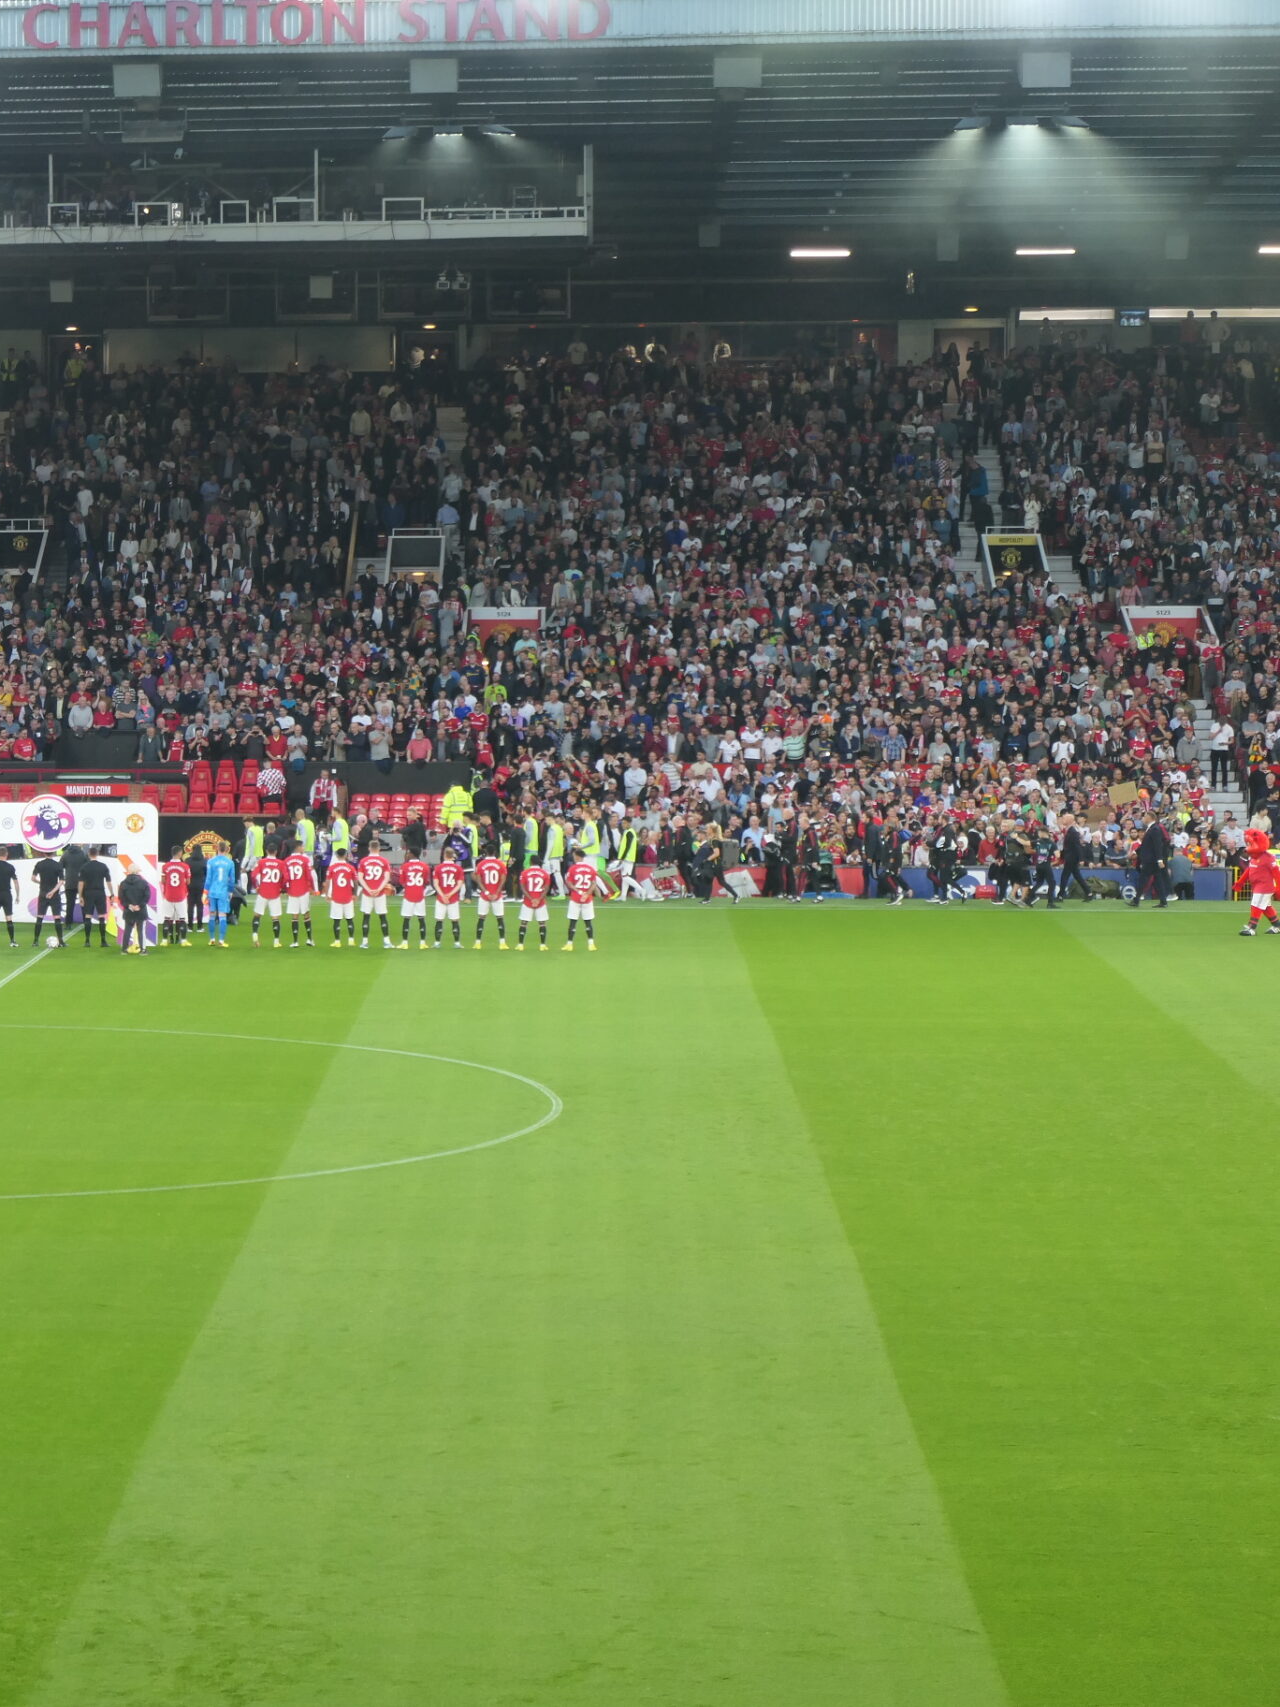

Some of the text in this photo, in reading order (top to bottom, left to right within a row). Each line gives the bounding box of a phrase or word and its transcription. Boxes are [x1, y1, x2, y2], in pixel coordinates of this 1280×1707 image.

[22, 0, 365, 49] CHARLTON
[398, 0, 610, 43] STAND
[65, 785, 112, 796] MANUTD.COM
[170, 872, 180, 887] 8
[217, 868, 224, 881] 1
[262, 868, 280, 883] 20
[288, 865, 303, 880] 19
[337, 872, 347, 887] 6
[365, 866, 383, 880] 39
[406, 872, 424, 887] 36
[484, 870, 499, 885] 10
[441, 873, 456, 888] 14
[527, 877, 544, 892] 12
[574, 874, 592, 889] 25
